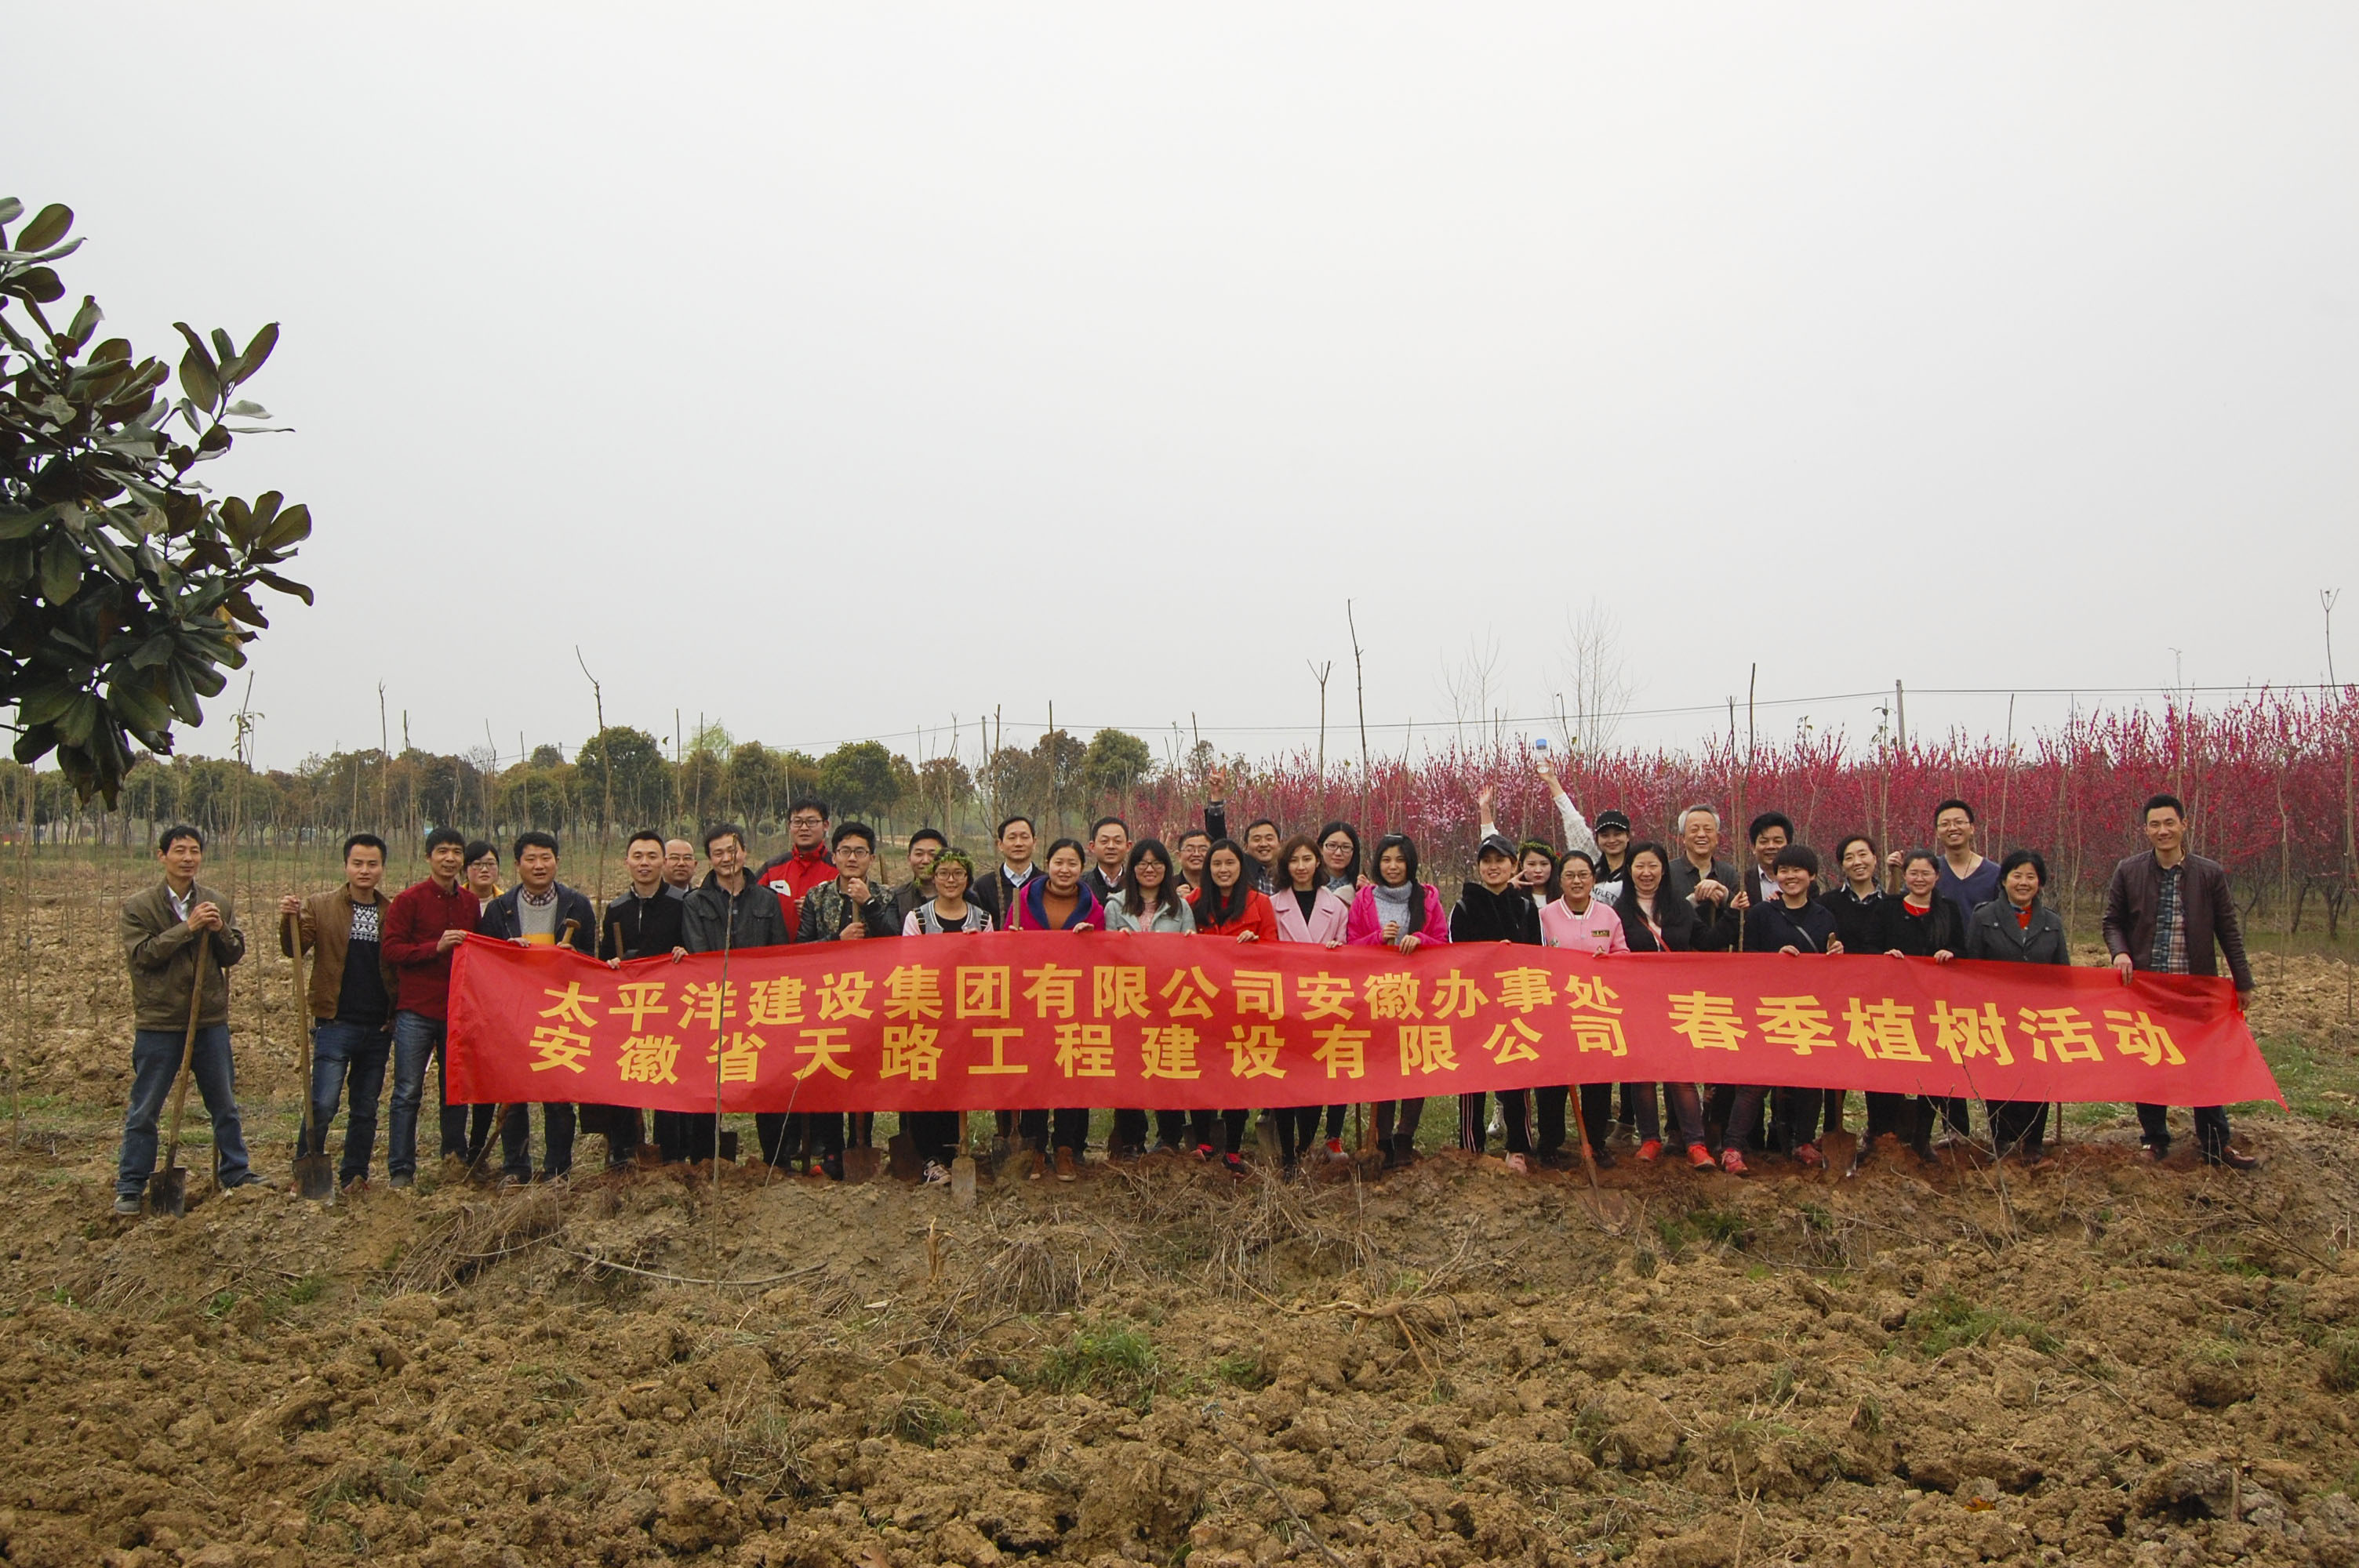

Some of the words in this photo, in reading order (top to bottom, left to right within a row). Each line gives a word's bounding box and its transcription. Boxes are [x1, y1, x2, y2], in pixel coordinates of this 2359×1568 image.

[538, 964, 1623, 1032] 太平洋建设集团有限公司安徽办事处
[1667, 991, 2186, 1066] 春季植树活动
[529, 1015, 1628, 1085] 安徽省天路工程建设有限公司
